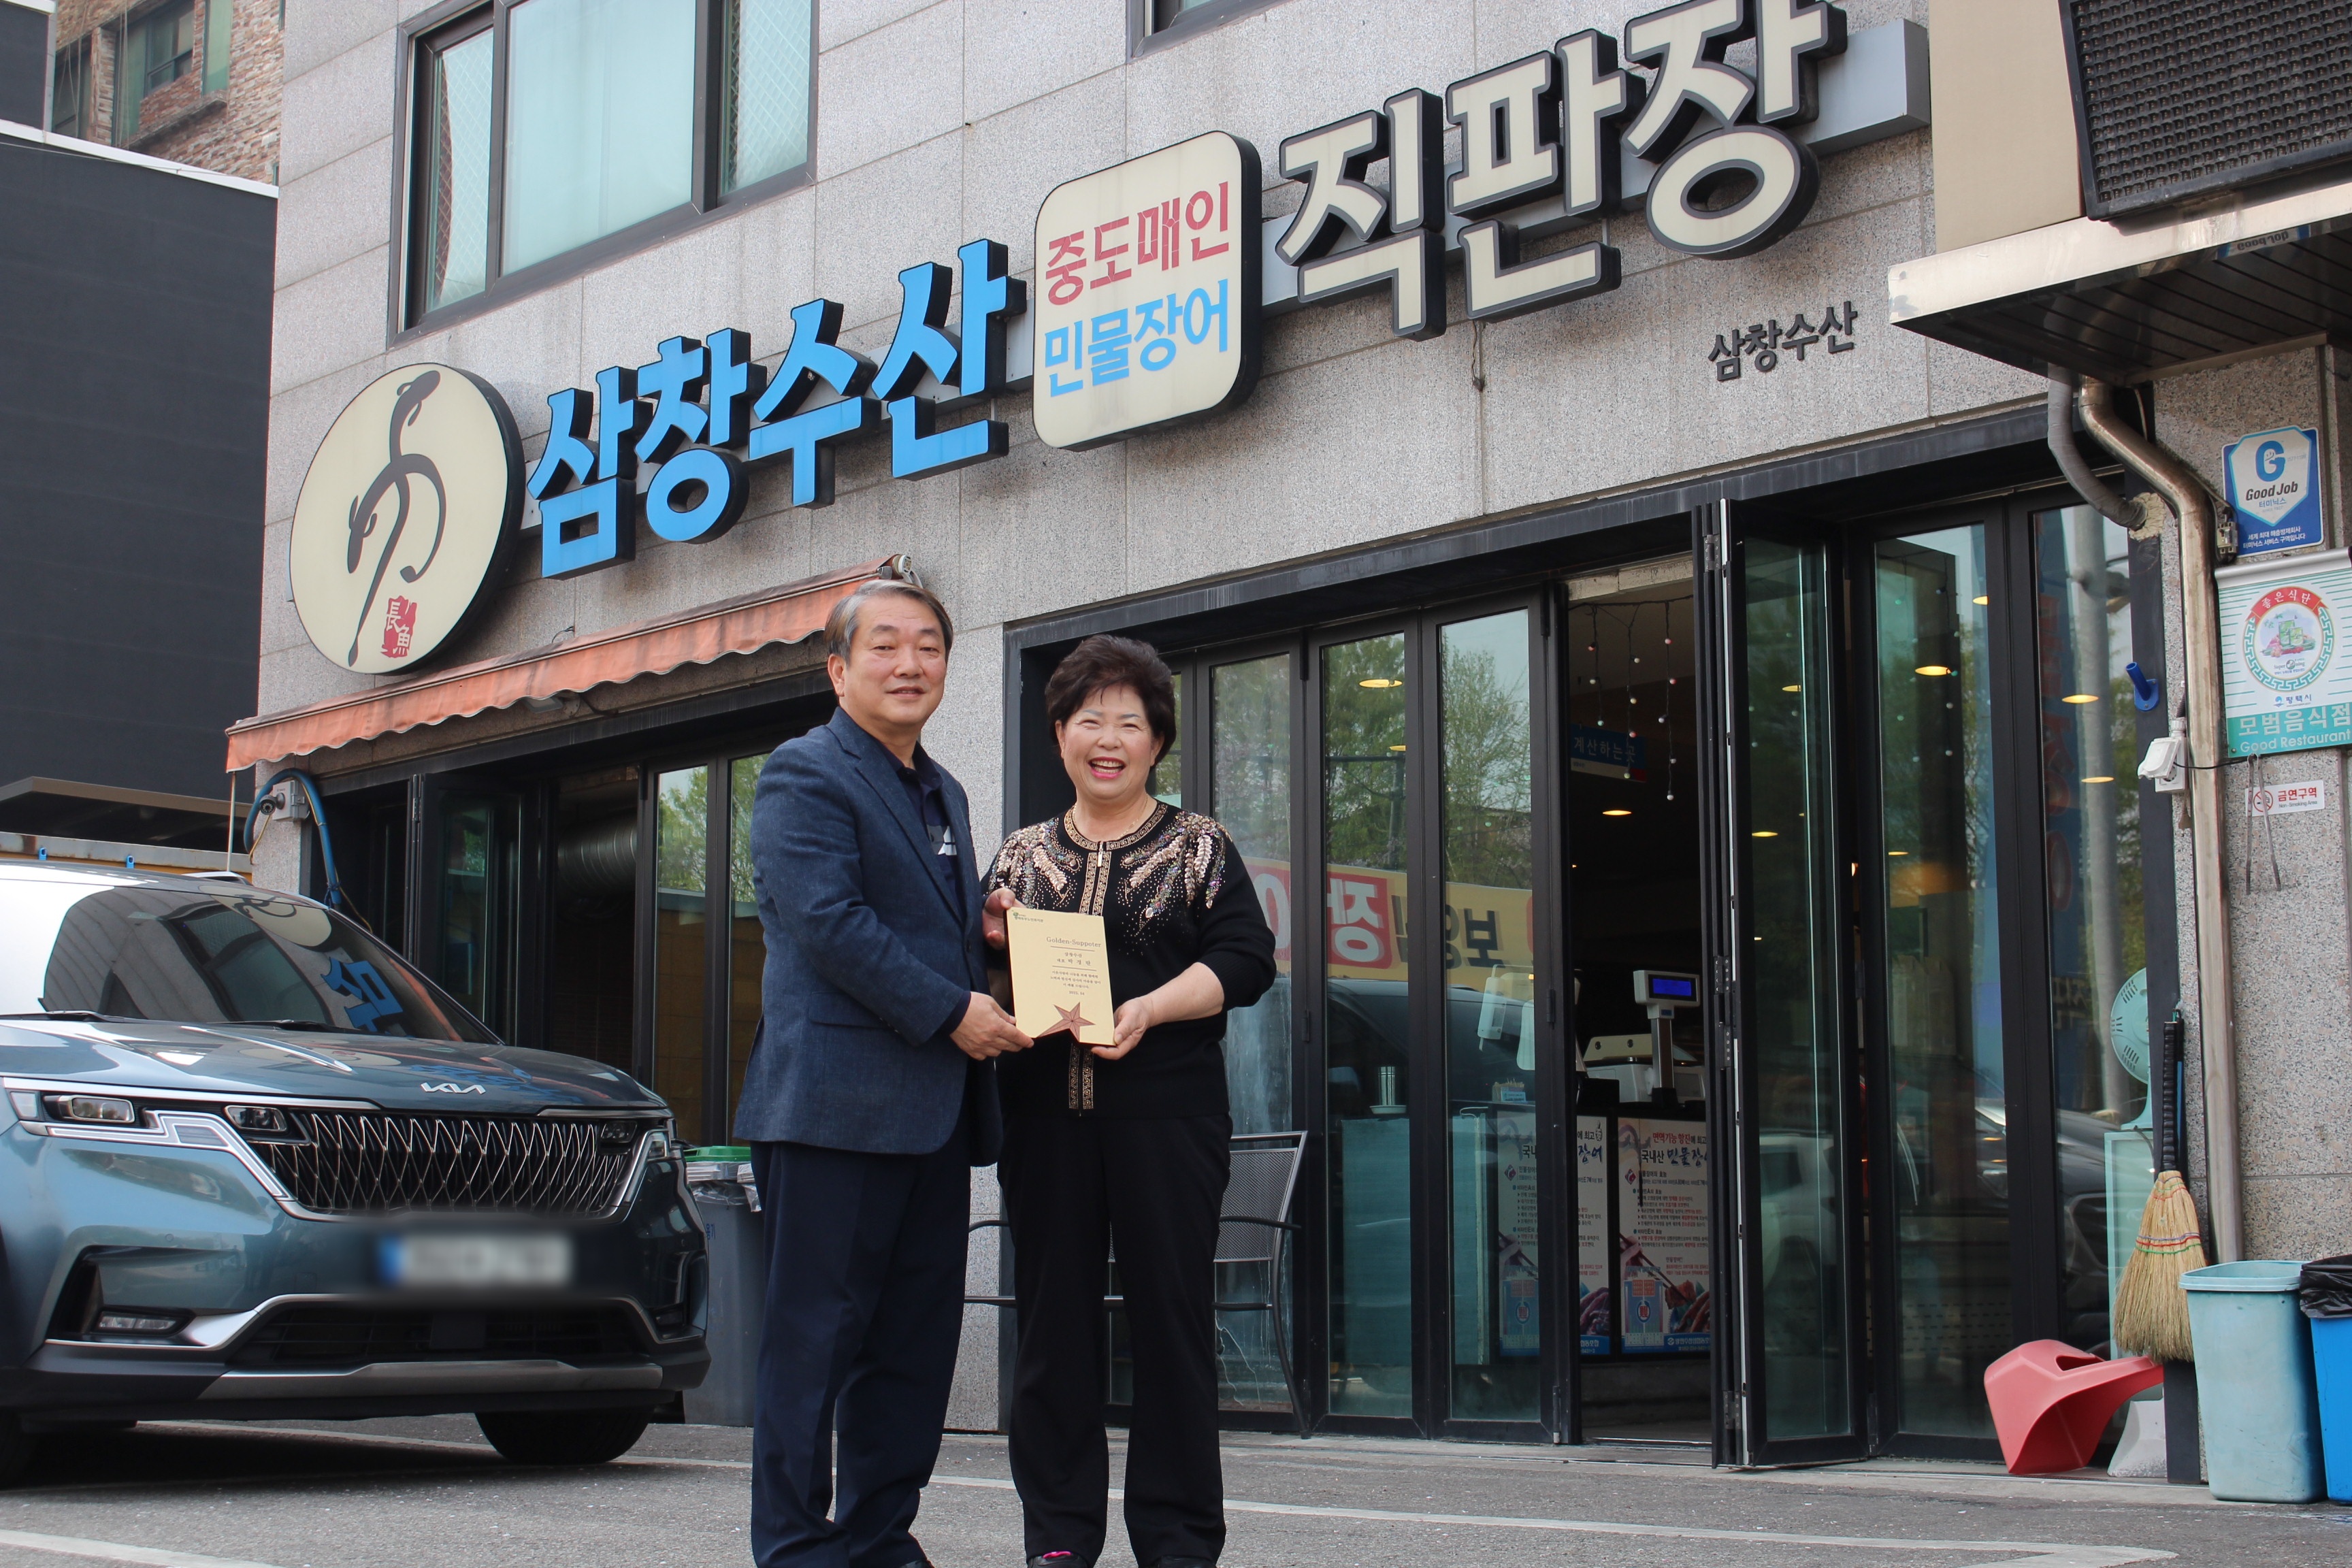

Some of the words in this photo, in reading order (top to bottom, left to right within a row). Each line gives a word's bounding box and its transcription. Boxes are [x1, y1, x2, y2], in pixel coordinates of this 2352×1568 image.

[1275, 0, 1848, 339] 직판장
[1045, 180, 1230, 307] 중도매인
[1044, 278, 1230, 397] 민물장어
[1707, 300, 1859, 382] 삼창수산
[527, 238, 1007, 578] 삼창수산
[2245, 485, 2275, 502] Good
[2276, 480, 2298, 495] Job
[2259, 497, 2287, 508] 터미닉스
[2242, 540, 2264, 549] 터미닉스
[2264, 537, 2279, 546] 서비스
[2280, 533, 2306, 544] 구역입니다
[2249, 532, 2258, 540] 세계
[2259, 530, 2270, 538] 최대
[2261, 588, 2311, 609] 좋은식단
[2285, 693, 2312, 704] 평택시
[2238, 702, 2351, 736] 모범음식점
[1573, 736, 1637, 763] 계산하는곳
[2240, 738, 2277, 753] Good
[2281, 729, 2351, 747] Restaurant
[2278, 787, 2317, 802] 금연구역
[1046, 936, 1101, 947] Golden-Suppoter
[1584, 1130, 1595, 1140] 최고
[1641, 1150, 1665, 1164] 국내산
